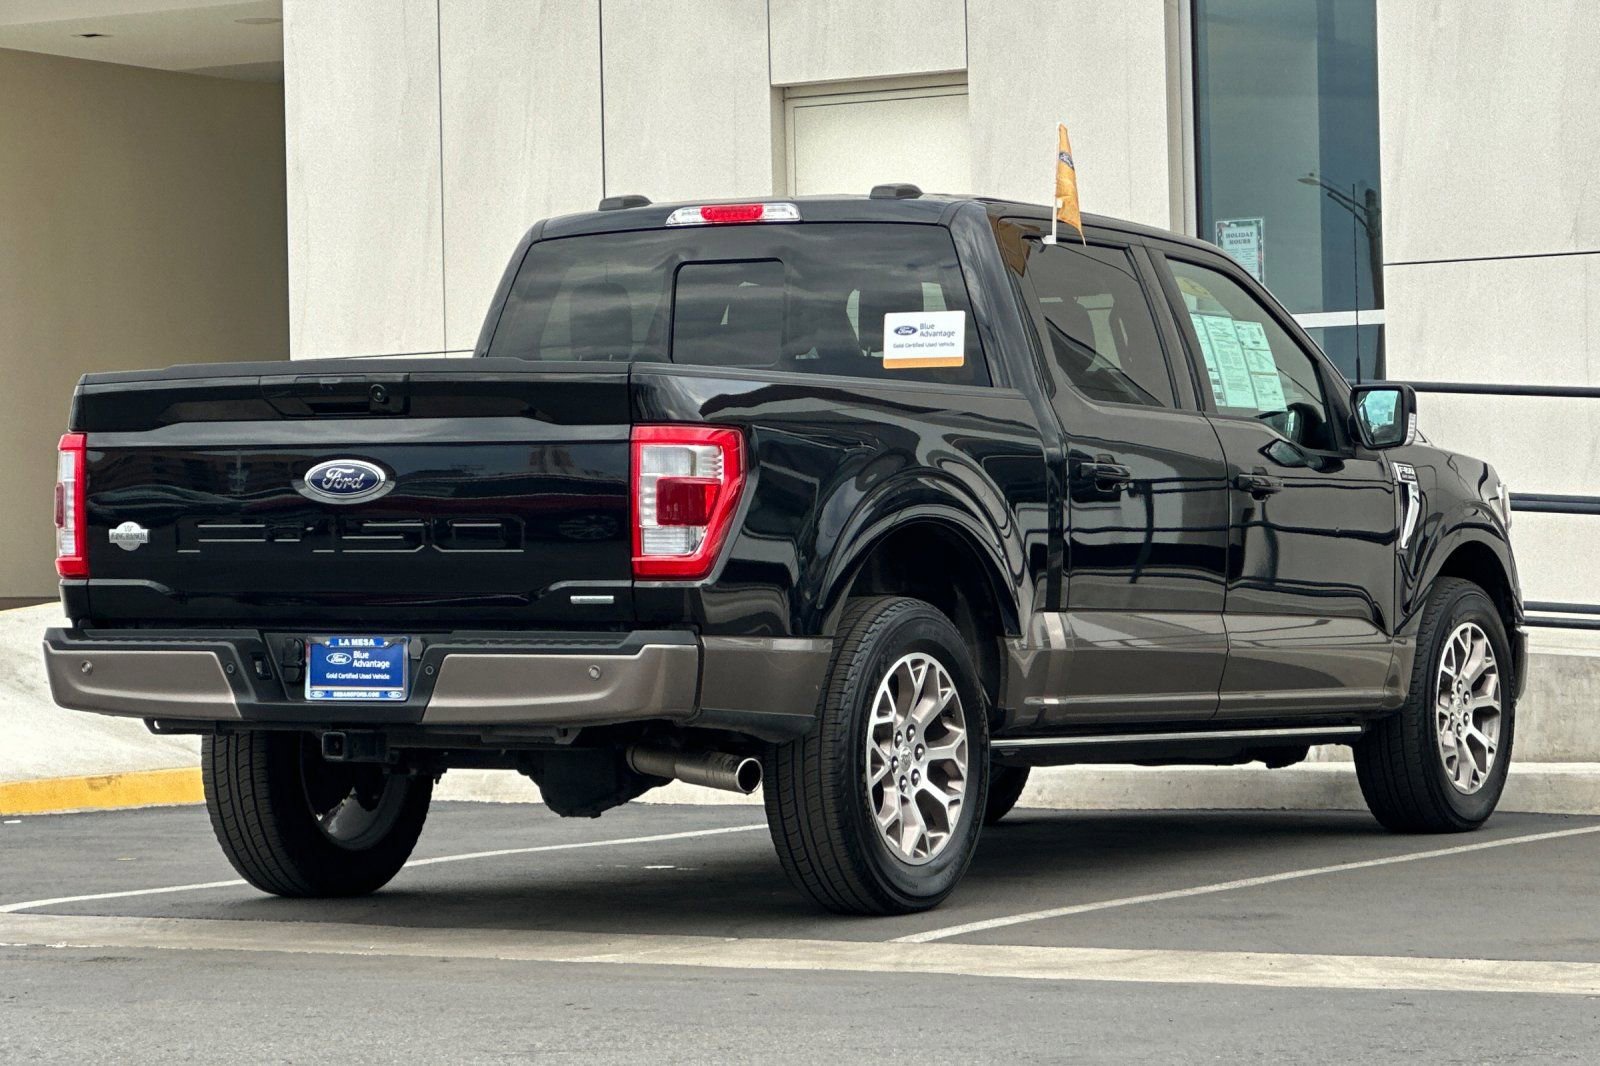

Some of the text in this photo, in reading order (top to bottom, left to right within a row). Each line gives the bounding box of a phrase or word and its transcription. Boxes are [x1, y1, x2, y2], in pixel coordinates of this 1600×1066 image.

[1225, 231, 1254, 239] HOLIDAY
[896, 326, 915, 335] Ford
[920, 330, 956, 338] Advantage
[321, 467, 365, 489] Ford
[175, 515, 526, 553] F-150
[338, 638, 375, 646] LA MESA
[330, 654, 348, 664] Ford
[353, 650, 369, 659] Blue
[352, 660, 391, 669] Advantage
